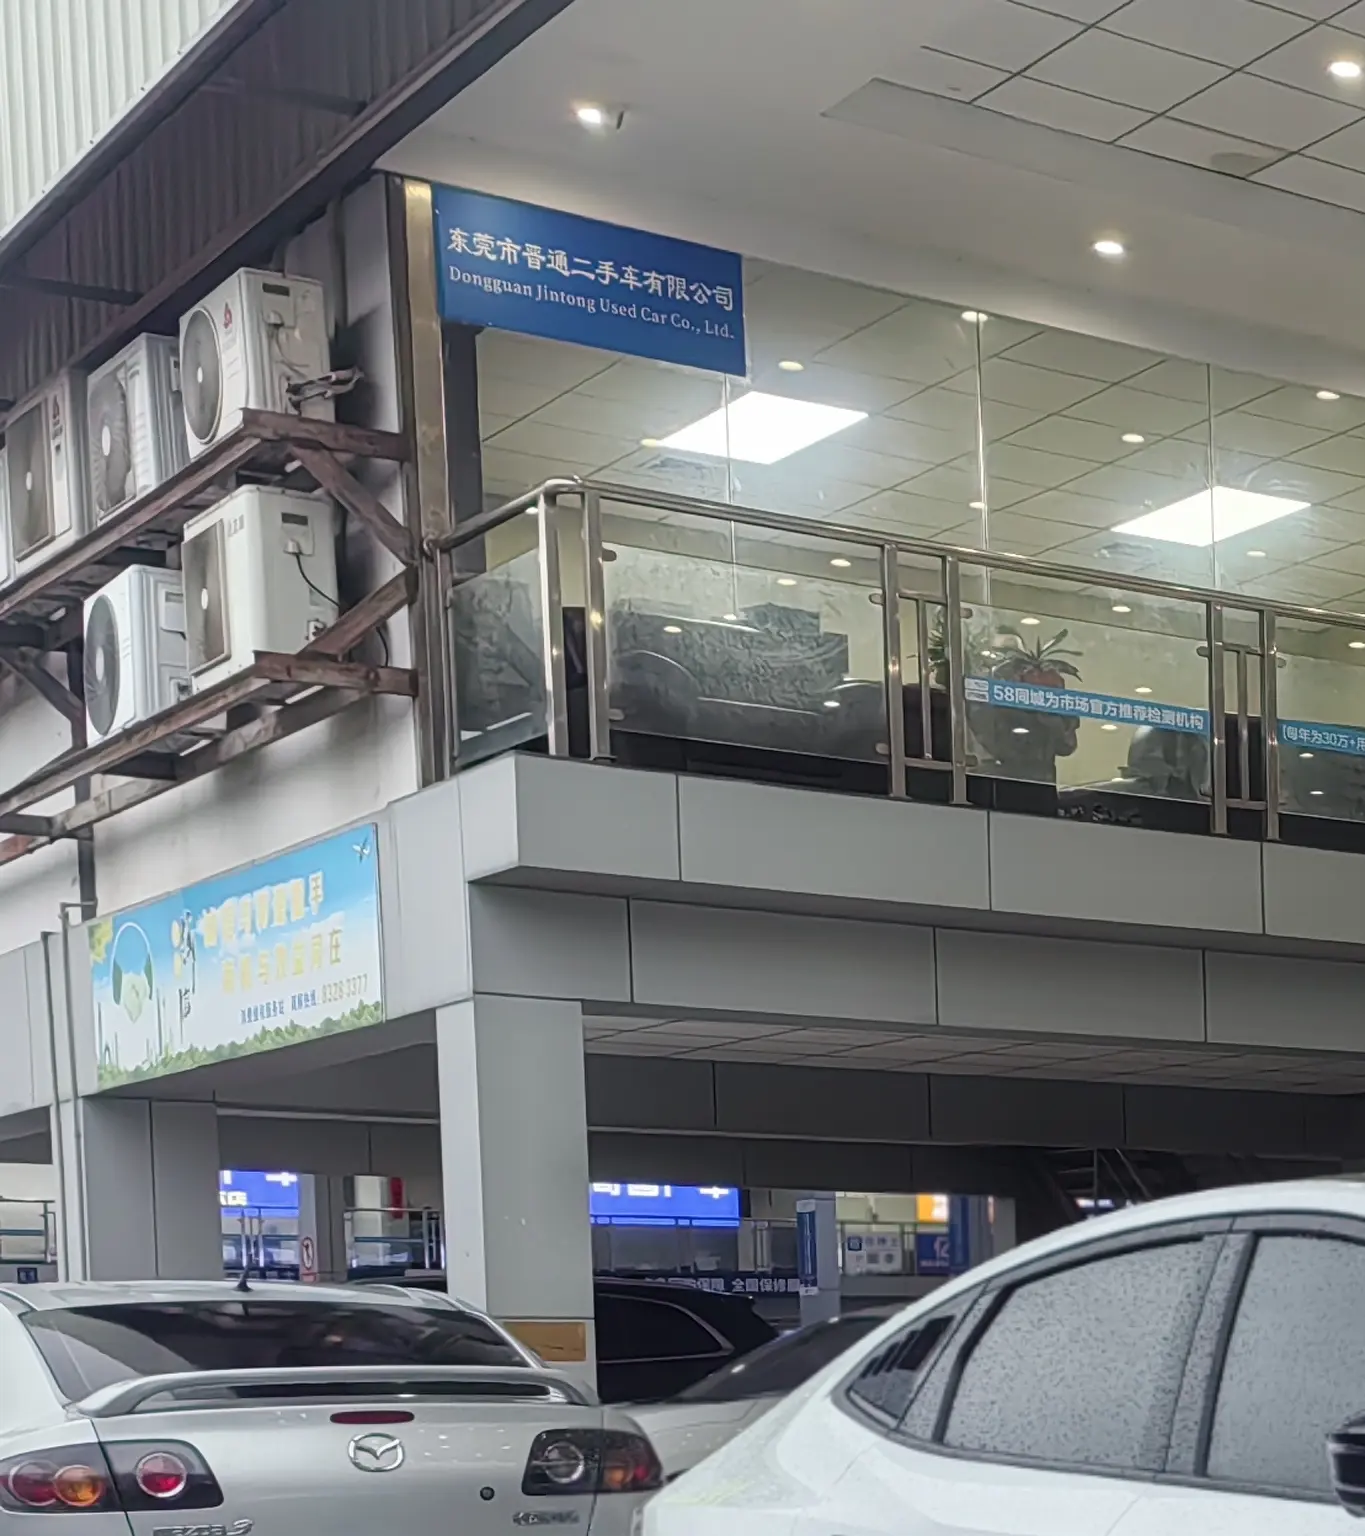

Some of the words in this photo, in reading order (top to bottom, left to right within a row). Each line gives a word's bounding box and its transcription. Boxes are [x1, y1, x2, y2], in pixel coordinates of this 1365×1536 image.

[447, 227, 734, 311] 东莞市晋通二手车有限公司
[449, 265, 532, 297] Dongguan
[535, 285, 596, 313] Jintong
[600, 298, 637, 319] Used
[641, 306, 668, 325] Car
[670, 313, 701, 335] Co.,
[705, 319, 735, 340] Ltd.
